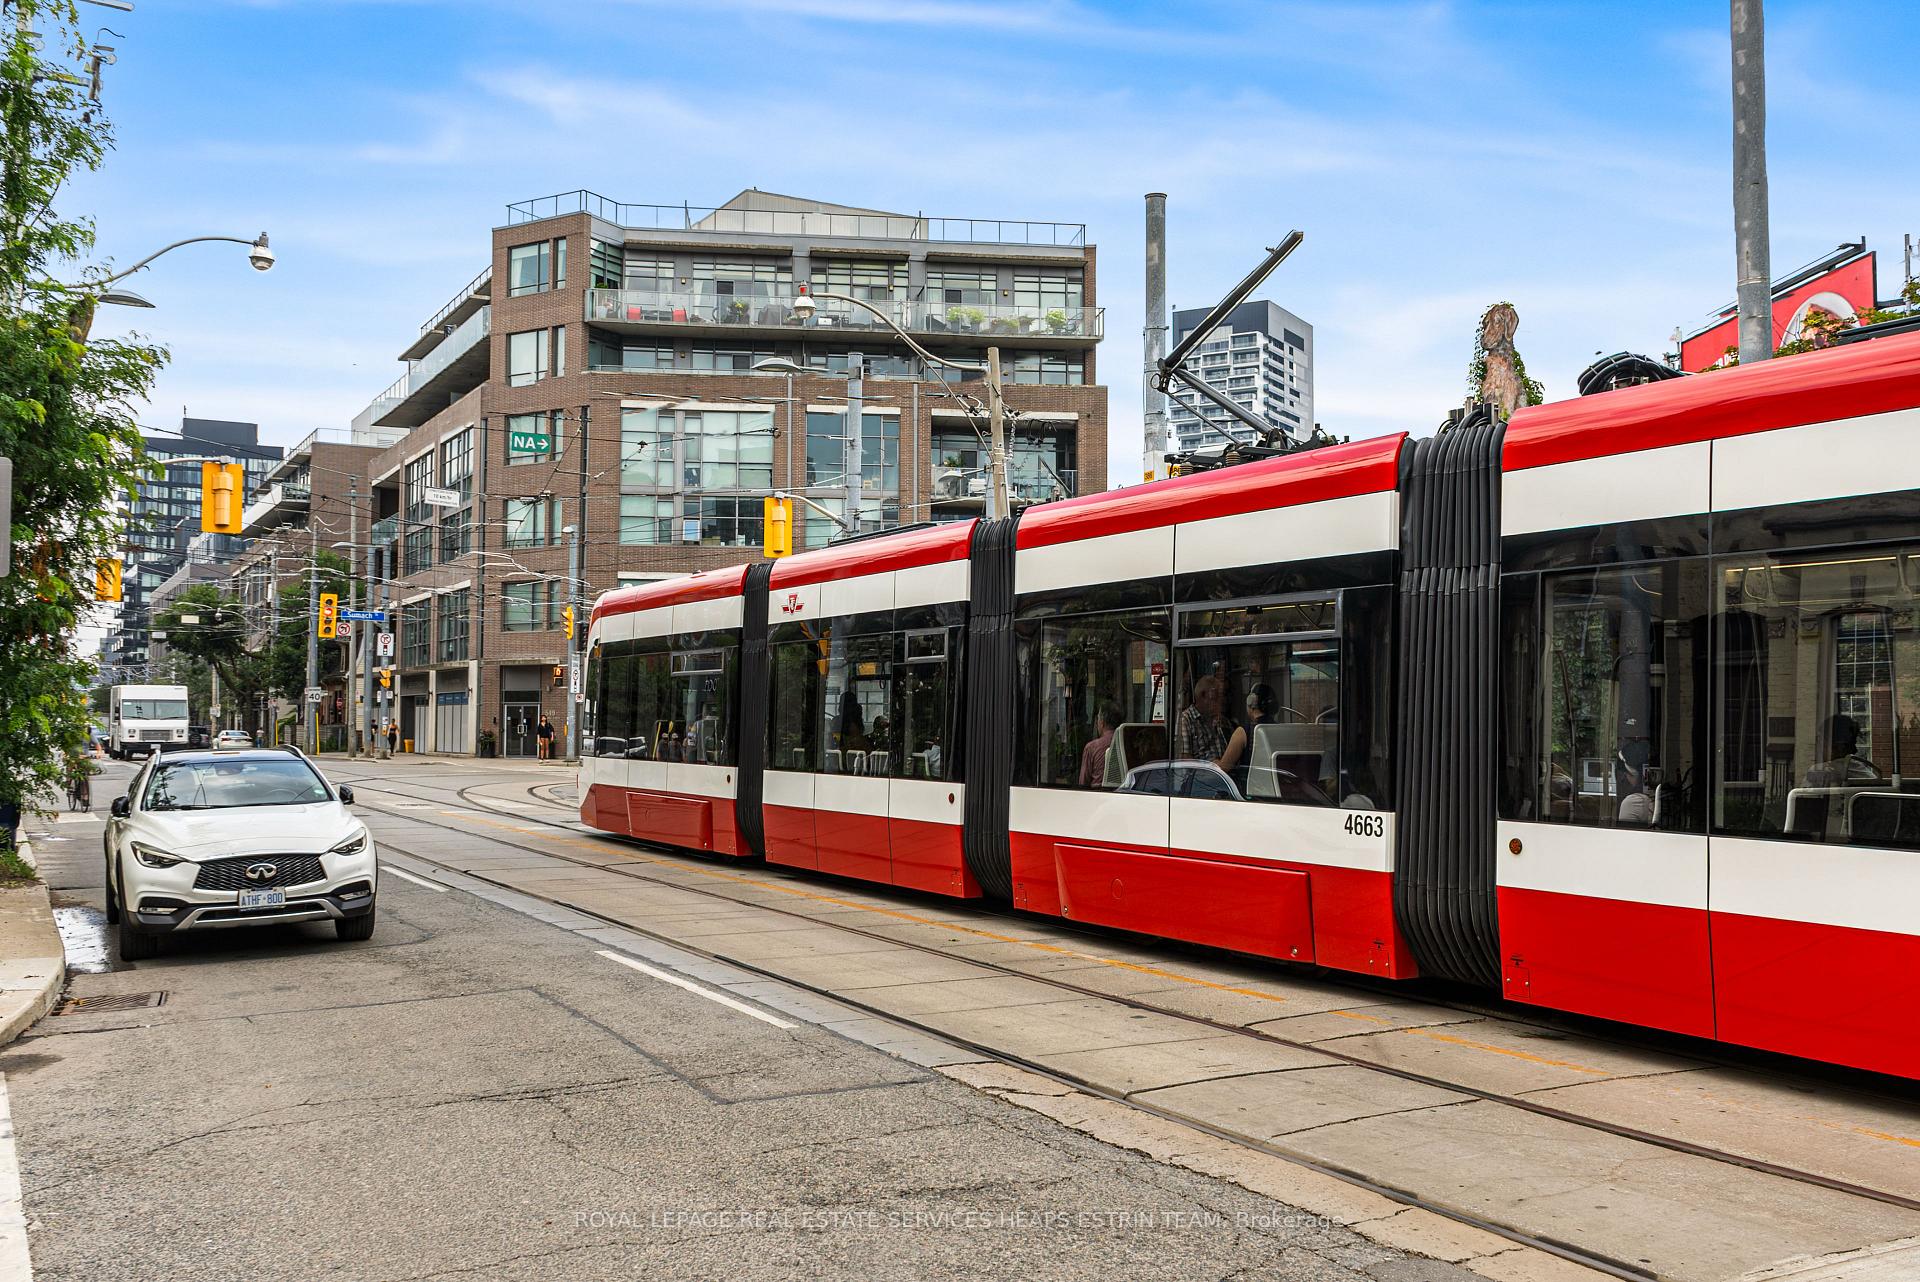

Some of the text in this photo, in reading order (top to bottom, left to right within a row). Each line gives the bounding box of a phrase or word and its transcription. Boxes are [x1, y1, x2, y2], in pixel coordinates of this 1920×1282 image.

[513, 435, 536, 449] NA
[347, 611, 373, 619] Sumach
[308, 693, 321, 701] 40
[1344, 813, 1384, 838] 4663
[267, 892, 283, 904] 800
